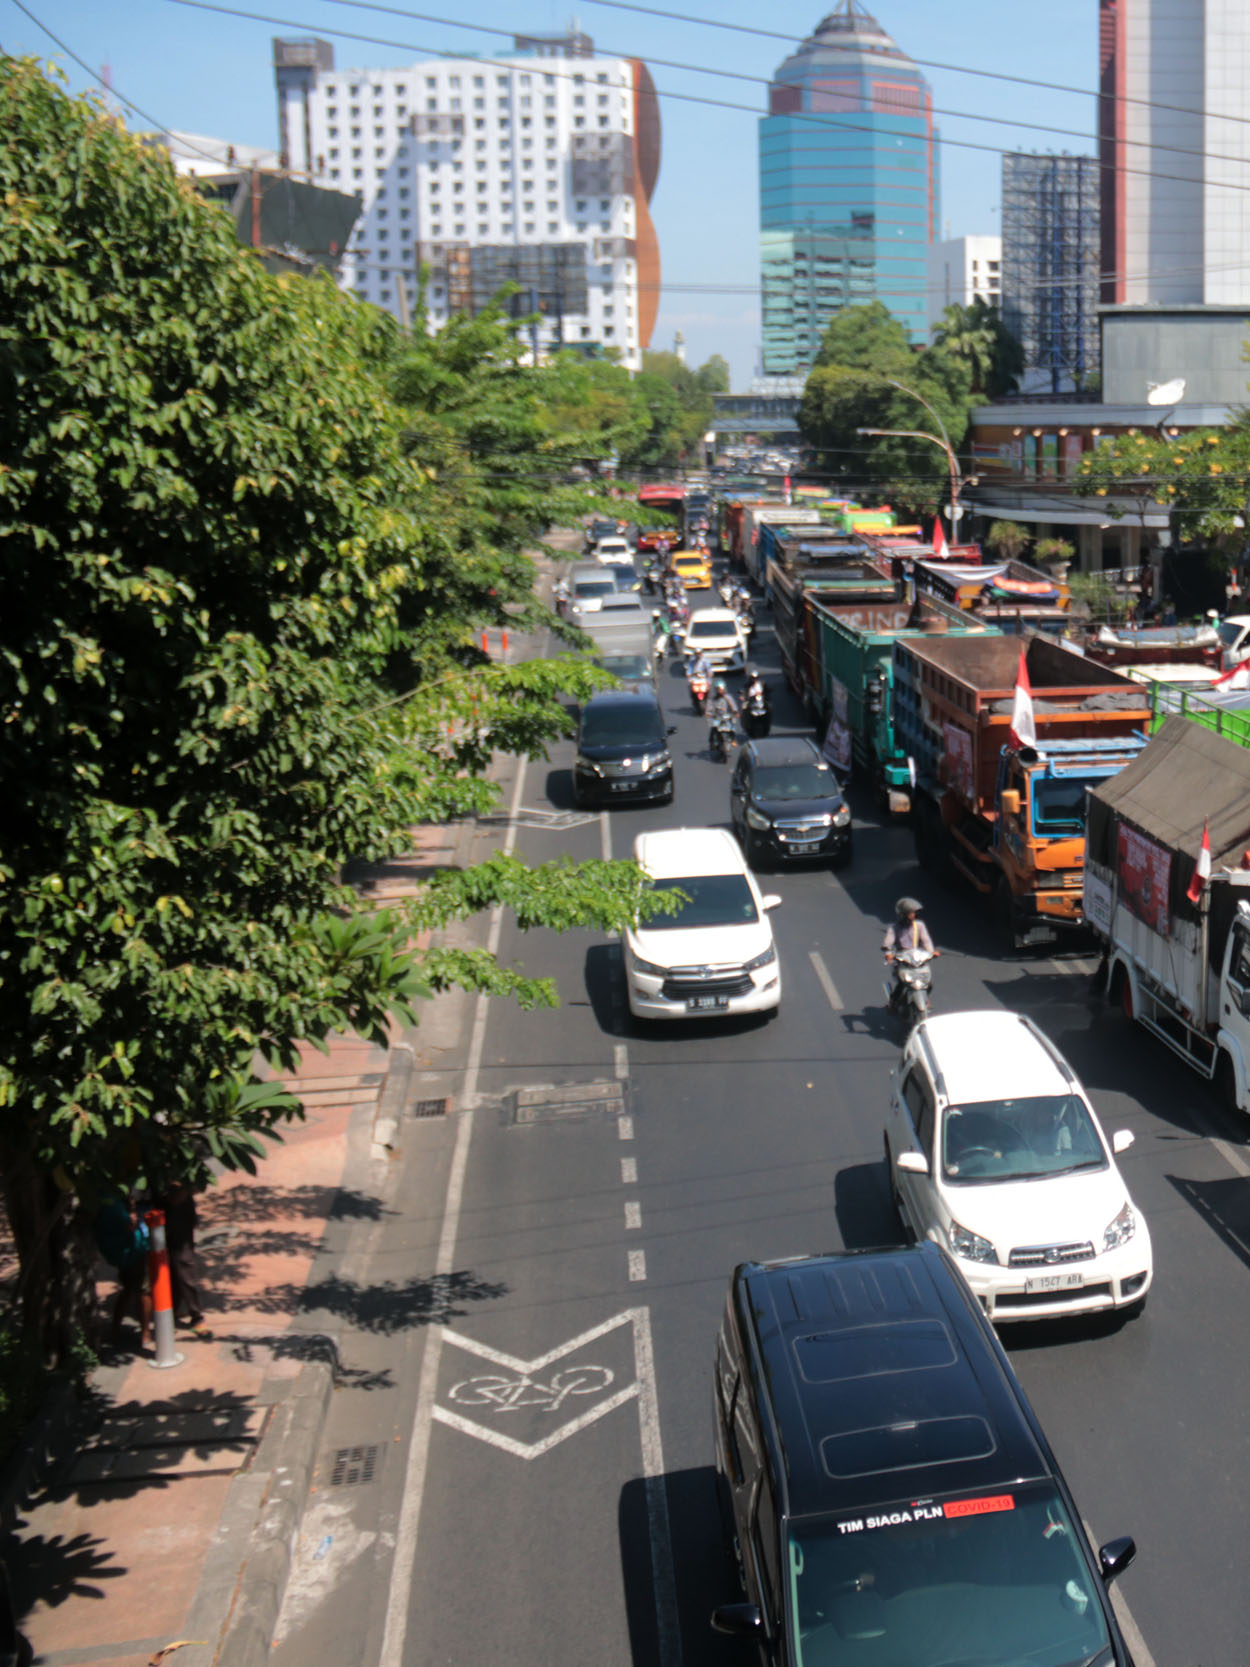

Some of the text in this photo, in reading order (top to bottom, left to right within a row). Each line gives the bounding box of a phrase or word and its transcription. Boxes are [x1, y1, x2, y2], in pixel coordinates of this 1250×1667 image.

[837, 1519, 864, 1534] TIM
[866, 1511, 912, 1530] SIAGA
[914, 1506, 943, 1521] PLN
[946, 1498, 1011, 1516] COVID-19
